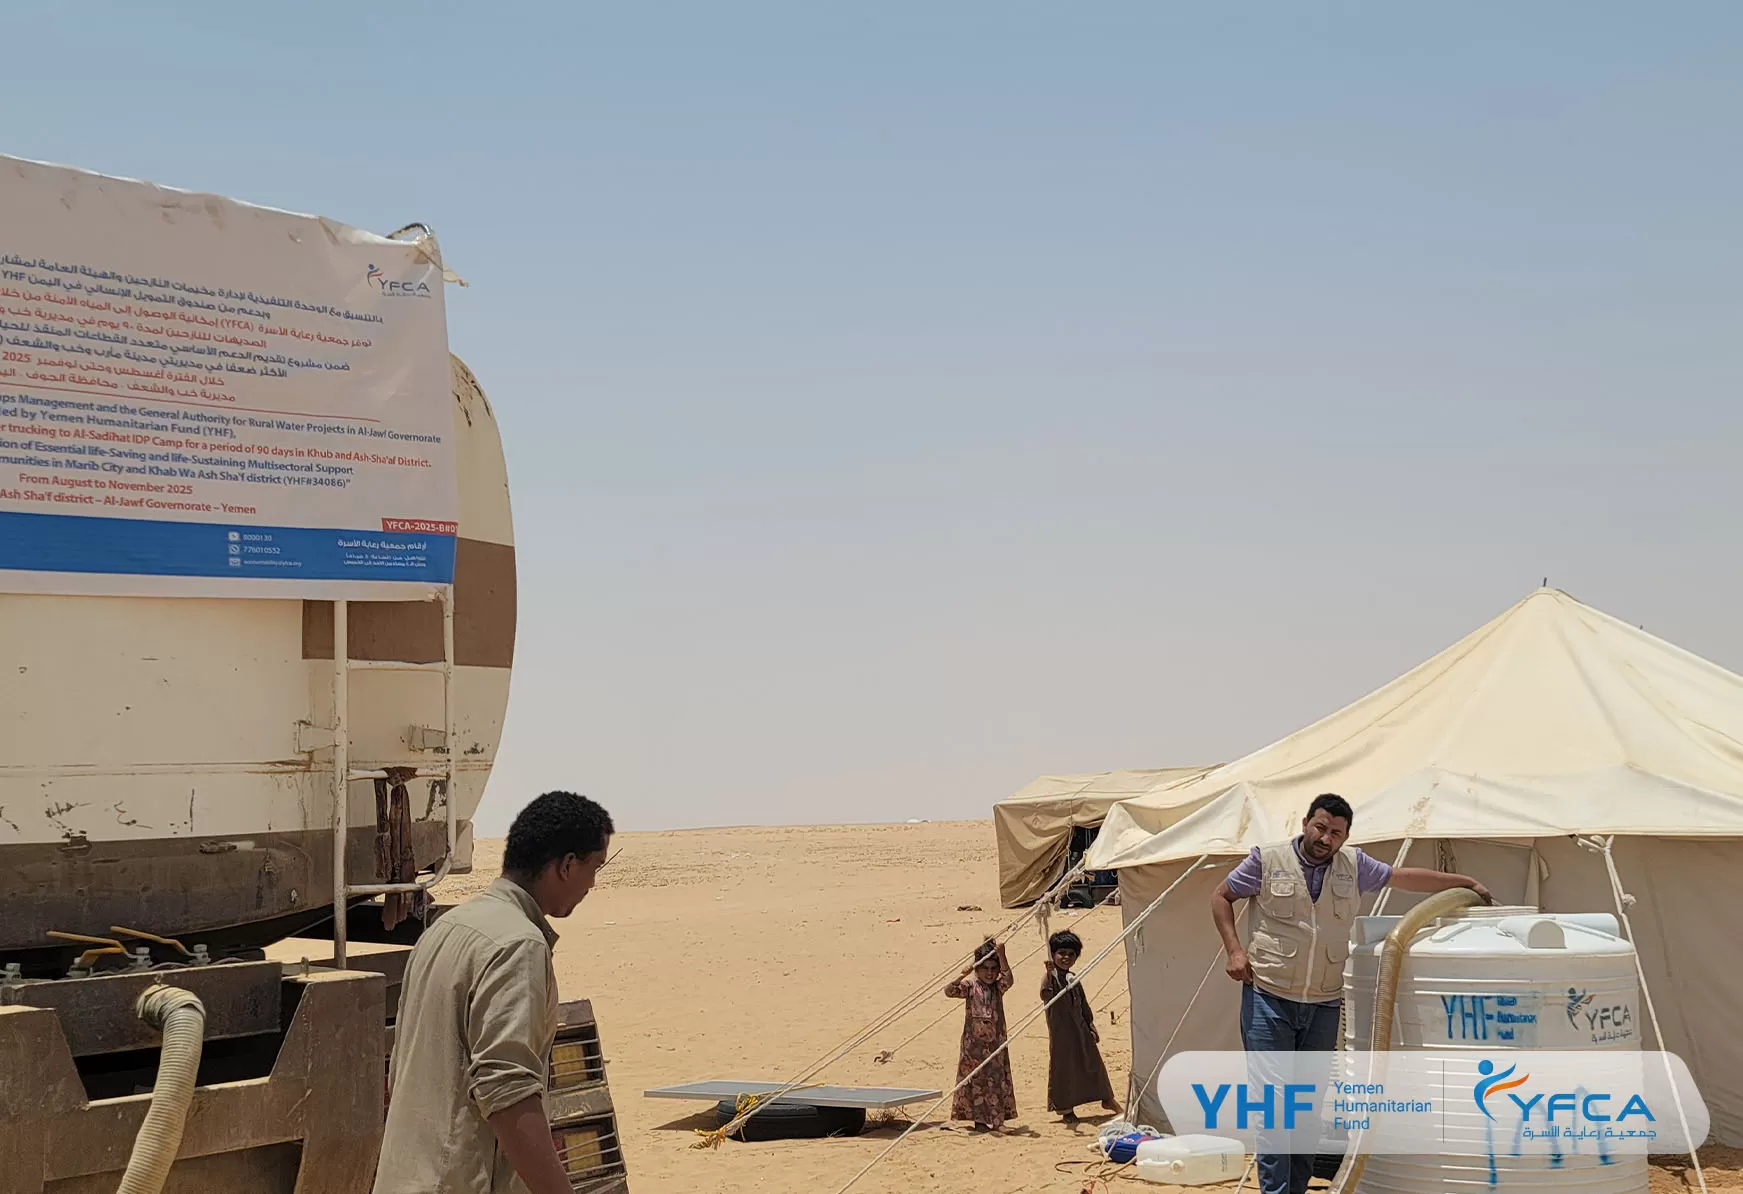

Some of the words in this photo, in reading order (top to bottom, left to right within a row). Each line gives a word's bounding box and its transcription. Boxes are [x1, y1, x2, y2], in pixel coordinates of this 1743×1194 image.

[38, 258, 78, 274] العامة
[2, 269, 27, 281] YHF
[28, 273, 61, 288] اليمن
[63, 279, 82, 292] في
[171, 280, 217, 297] مخيمات
[378, 277, 430, 293] YFCA
[22, 289, 41, 301] من
[80, 299, 111, 312] المياه
[177, 297, 216, 310] صندوق
[218, 302, 235, 313] من
[294, 299, 327, 314] الوحدة
[134, 307, 176, 321] الوصول
[329, 307, 341, 317] مع
[77, 315, 96, 328] في
[97, 318, 120, 329] يوم
[220, 319, 254, 333] (YFCA)
[136, 323, 163, 335] لمدة
[290, 327, 315, 342] رعاية
[129, 338, 168, 350] متعدد
[316, 331, 349, 346] جمعية
[2, 350, 32, 363] 2025
[124, 350, 157, 364] مدينة
[218, 350, 252, 360] الدعم
[253, 352, 286, 364] تقديم
[204, 361, 223, 373] في
[288, 357, 323, 368] مشروع
[324, 360, 350, 371] ضمن
[166, 370, 197, 384] الفترة
[199, 374, 225, 387] خلال
[18, 394, 94, 411] Management
[96, 403, 117, 413] and
[119, 404, 137, 415] the
[139, 407, 180, 420] General
[182, 411, 231, 426] Authority
[232, 416, 247, 426] for
[249, 418, 274, 429] Rural
[275, 420, 305, 431] Water
[307, 423, 345, 435] Projects
[347, 425, 356, 435] in
[388, 430, 441, 444] Governorate
[21, 408, 37, 421] by
[40, 410, 84, 424] Yemen
[87, 415, 168, 433] Humanitarian
[171, 422, 200, 435] Fund
[202, 426, 237, 439] (YHF),
[8, 423, 56, 439] trucking
[59, 428, 70, 437] to
[73, 428, 130, 443] Al-Sadihat
[132, 434, 150, 444] IDP
[152, 436, 183, 449] Camp
[185, 439, 200, 449] for
[201, 442, 208, 450] a
[210, 443, 243, 454] period
[245, 444, 255, 454] of
[257, 445, 270, 455] 90
[271, 446, 294, 458] days
[295, 448, 304, 457] in
[307, 448, 333, 459] Khub
[335, 451, 352, 460] and
[398, 456, 432, 468] District.
[20, 440, 34, 450] of
[35, 441, 86, 455] Essential
[88, 445, 146, 462] life-Saving
[148, 452, 169, 462] and
[171, 452, 246, 470] life-Sustaining
[248, 459, 314, 473] Multisectoral
[316, 463, 355, 475] Support
[52, 457, 63, 468] in
[65, 459, 100, 471] Marib
[101, 462, 124, 475] City
[125, 465, 146, 474] and
[149, 466, 177, 477] Khab
[179, 468, 196, 478] Wa
[198, 470, 218, 480] Ash
[247, 473, 281, 484] district
[19, 472, 49, 485] From
[52, 475, 93, 489] August
[95, 480, 106, 489] to
[109, 479, 165, 493] November
[167, 484, 193, 495] 2025
[0, 488, 21, 499] Ash
[54, 492, 95, 505] district
[104, 495, 144, 508] Al-Jawf
[146, 498, 212, 513] Governorate
[221, 502, 257, 515] Yemen
[380, 540, 406, 550] جمعية
[1440, 995, 1494, 1040] YHF
[1585, 1004, 1632, 1031] YFCA
